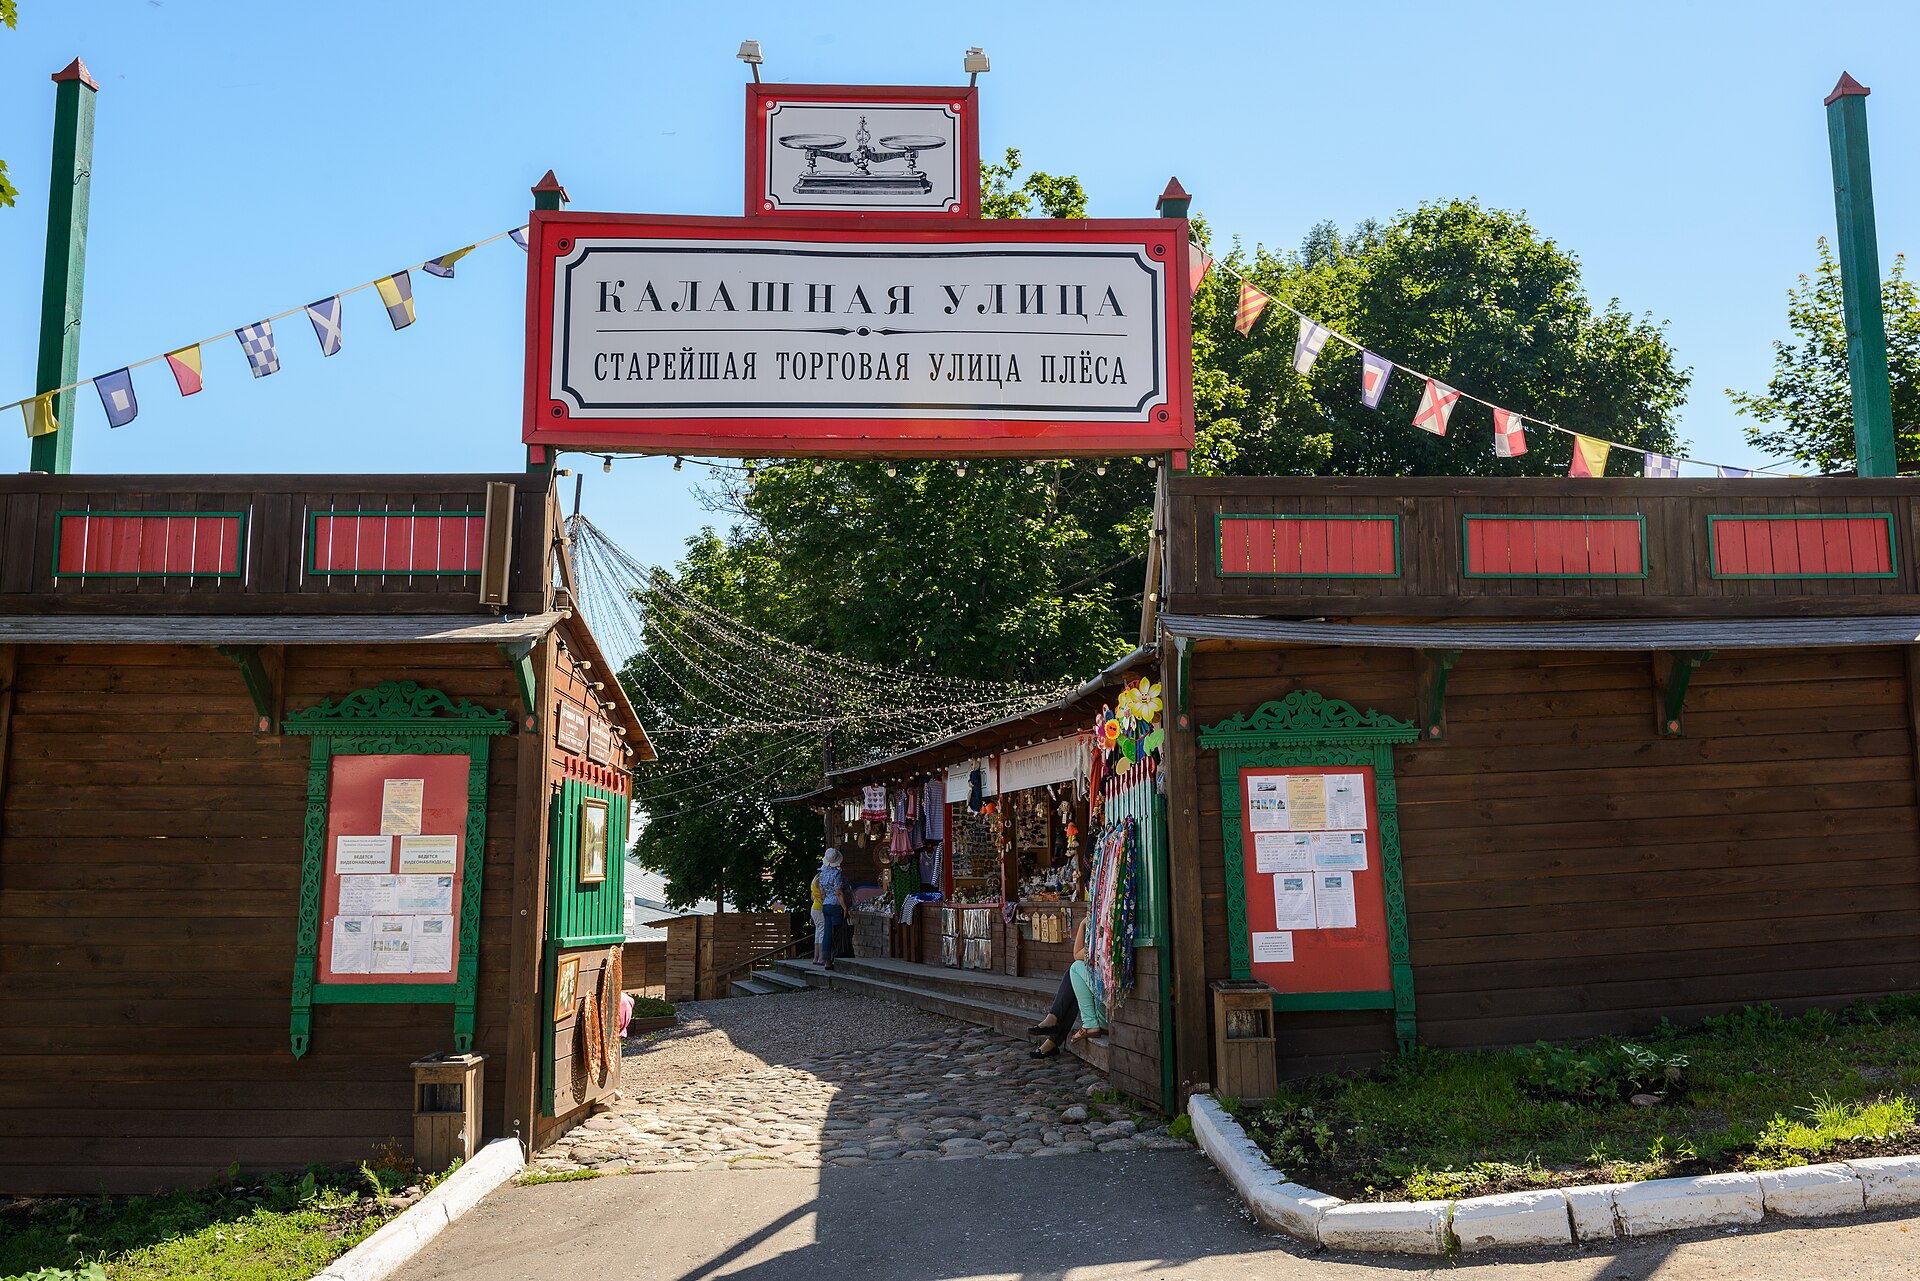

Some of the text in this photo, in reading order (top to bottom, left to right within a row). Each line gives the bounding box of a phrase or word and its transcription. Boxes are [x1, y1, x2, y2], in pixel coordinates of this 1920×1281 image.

[595, 280, 1126, 324] КАЛАШНАЯ УЛИЦА
[595, 346, 1127, 390] СТАРЕЙШАЯ ТОРГОВАЯ УЛИЦА ПЛЁСА
